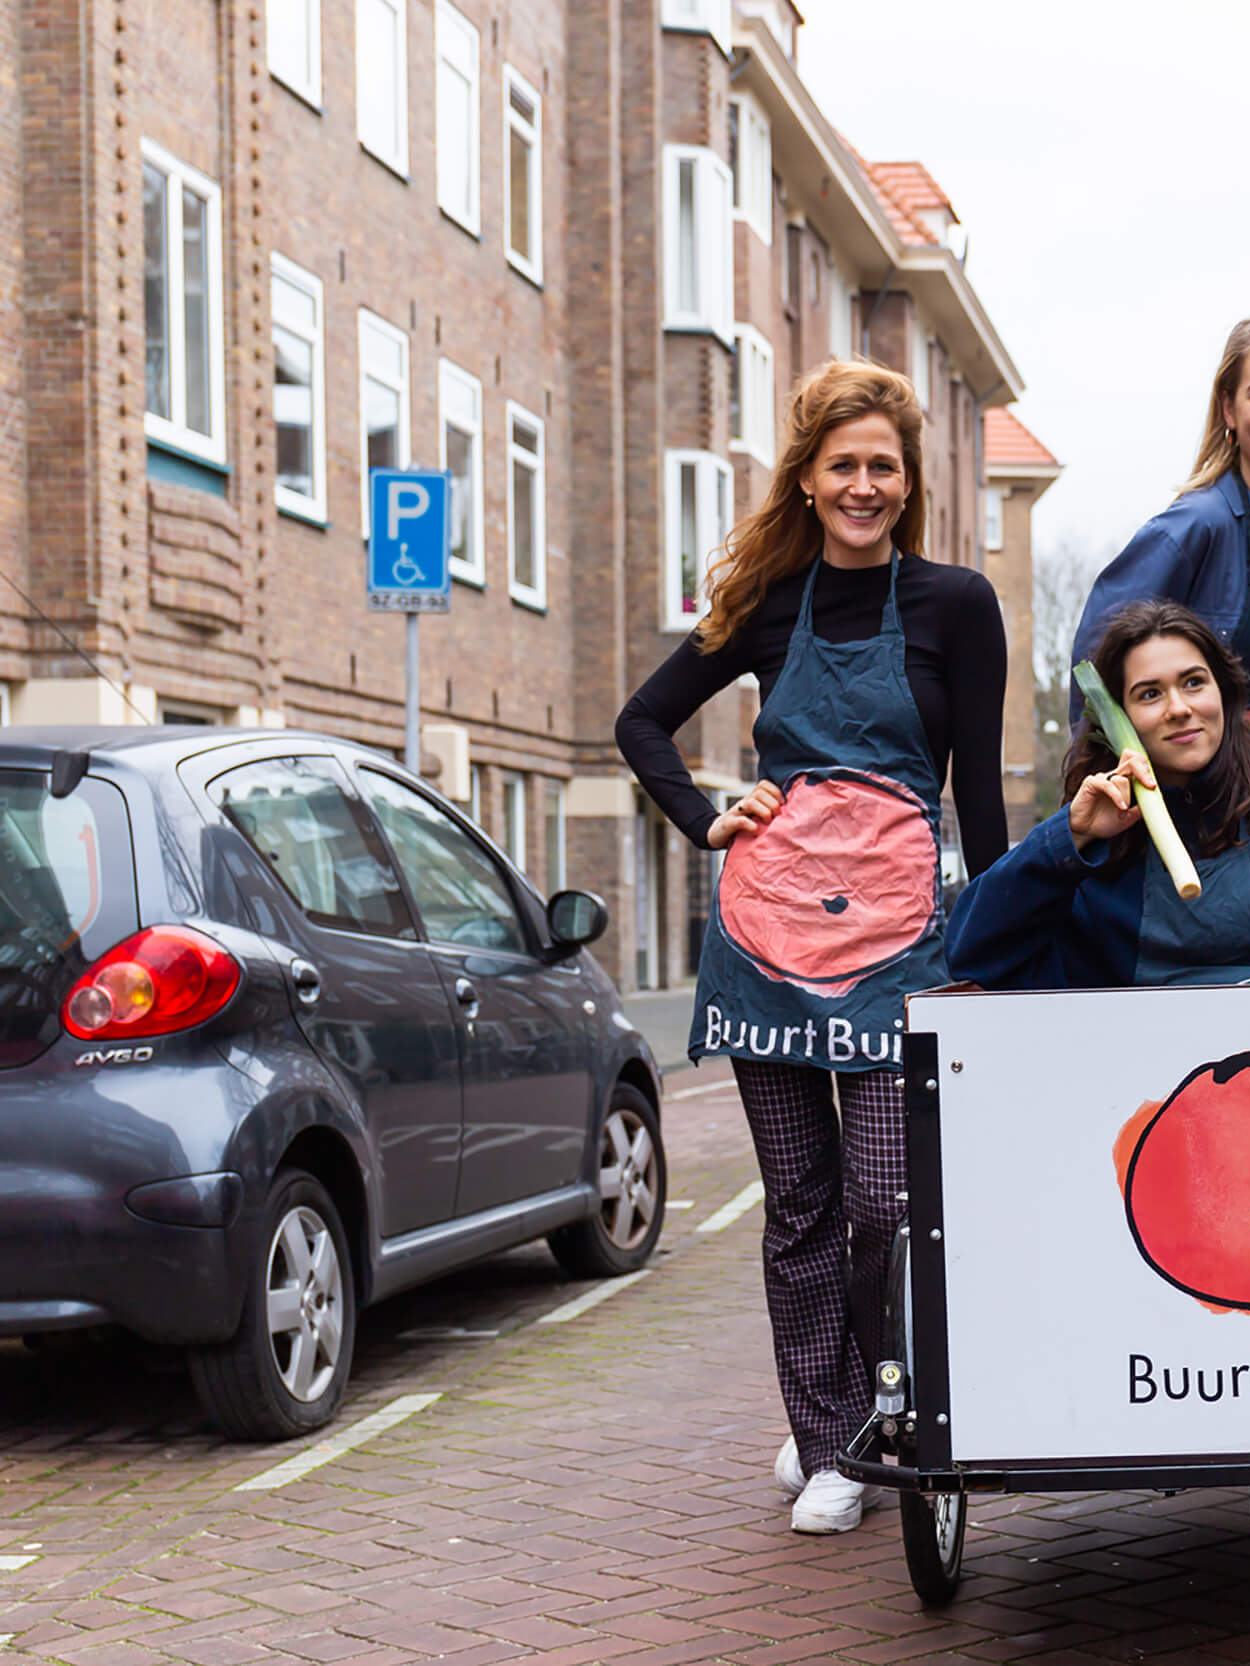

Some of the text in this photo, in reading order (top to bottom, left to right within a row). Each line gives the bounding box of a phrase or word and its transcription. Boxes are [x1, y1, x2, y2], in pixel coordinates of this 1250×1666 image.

[388, 481, 430, 540] P
[75, 1047, 153, 1066] AYGO
[705, 1005, 902, 1063] BuurtBui
